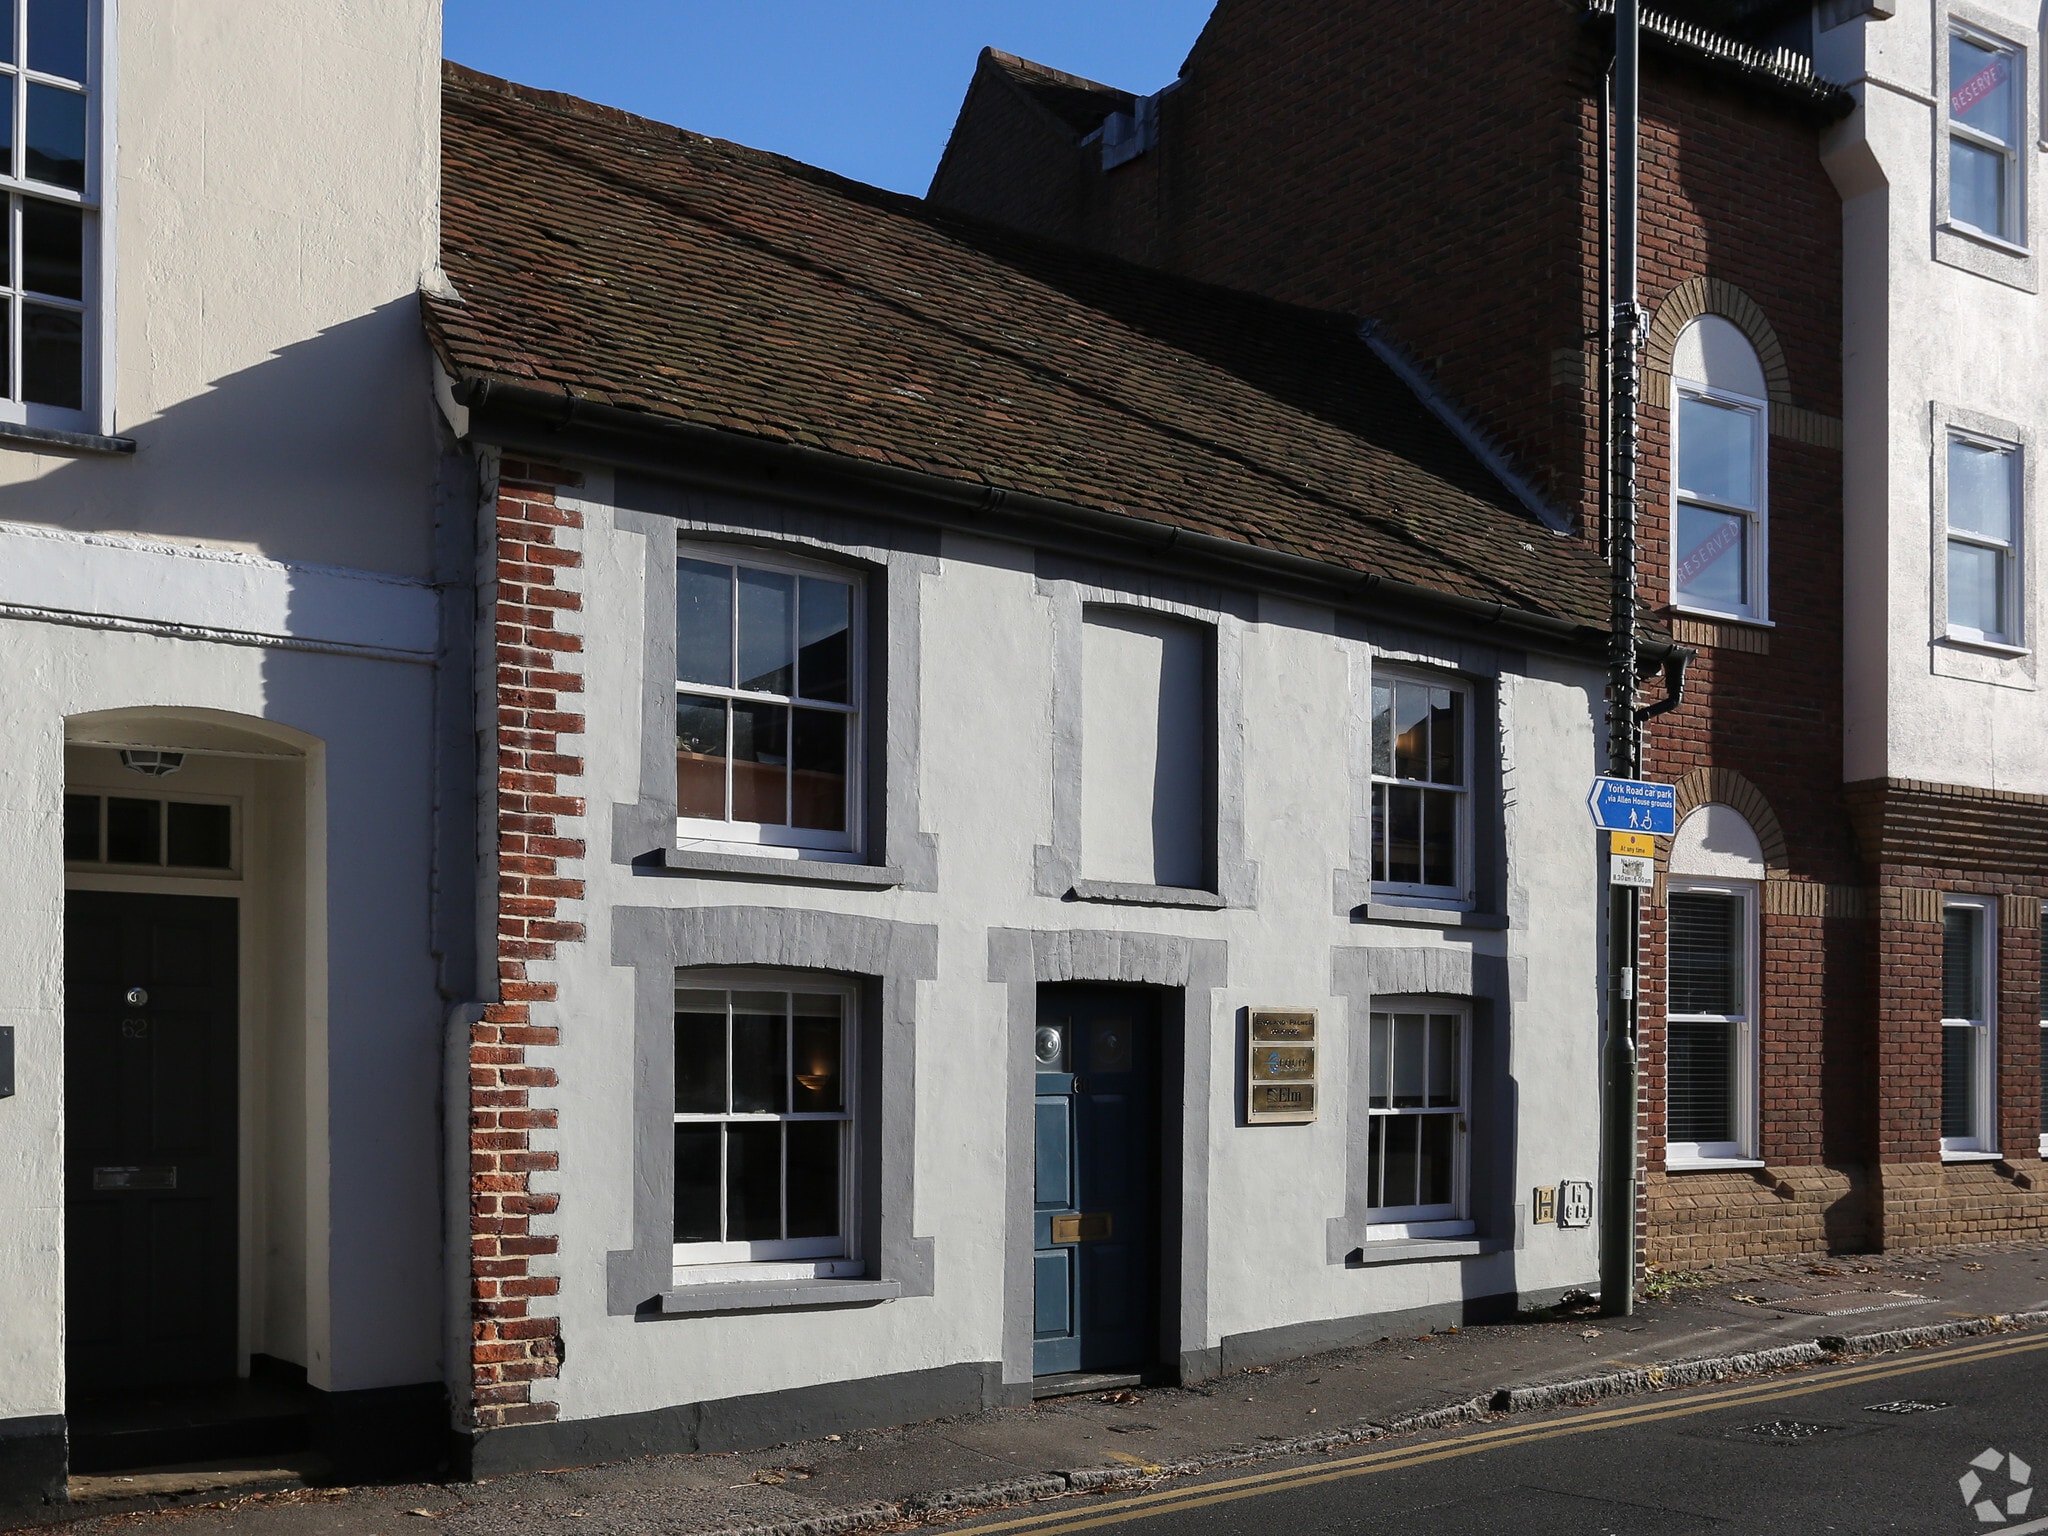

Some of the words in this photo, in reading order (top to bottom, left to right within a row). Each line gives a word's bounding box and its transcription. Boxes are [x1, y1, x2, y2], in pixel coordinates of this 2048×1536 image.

[1677, 519, 1739, 583] RESERVED
[1607, 782, 1625, 794] York
[1625, 784, 1644, 796] Road
[1644, 789, 1656, 797] car
[1656, 790, 1672, 799] park
[1607, 794, 1616, 803] via
[1616, 795, 1632, 804] Allen
[1632, 796, 1650, 806] House
[1650, 799, 1673, 809] grounds
[1626, 846, 1635, 854] any
[121, 1017, 149, 1039] 62
[1279, 1087, 1302, 1102] Elm
